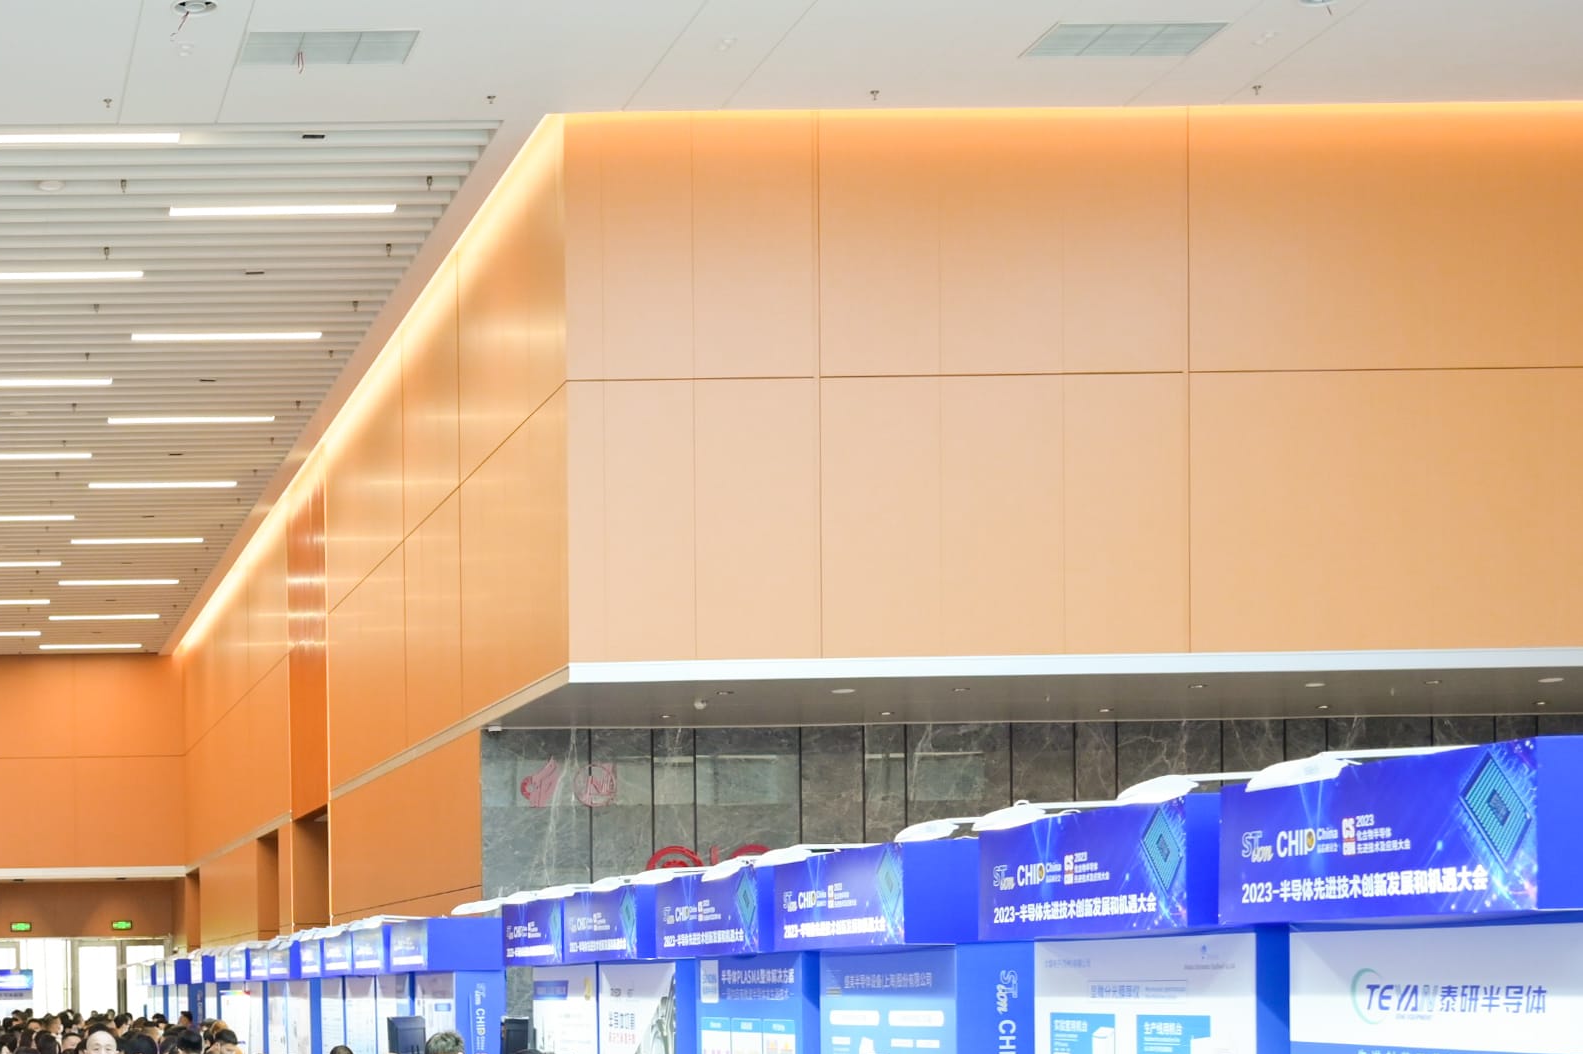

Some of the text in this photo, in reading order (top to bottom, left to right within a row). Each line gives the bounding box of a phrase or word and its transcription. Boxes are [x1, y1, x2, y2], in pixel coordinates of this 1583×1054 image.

[1355, 814, 1374, 828] 2023
[1276, 828, 1316, 858] CHIP
[1440, 984, 1548, 1014] 泰研半导体
